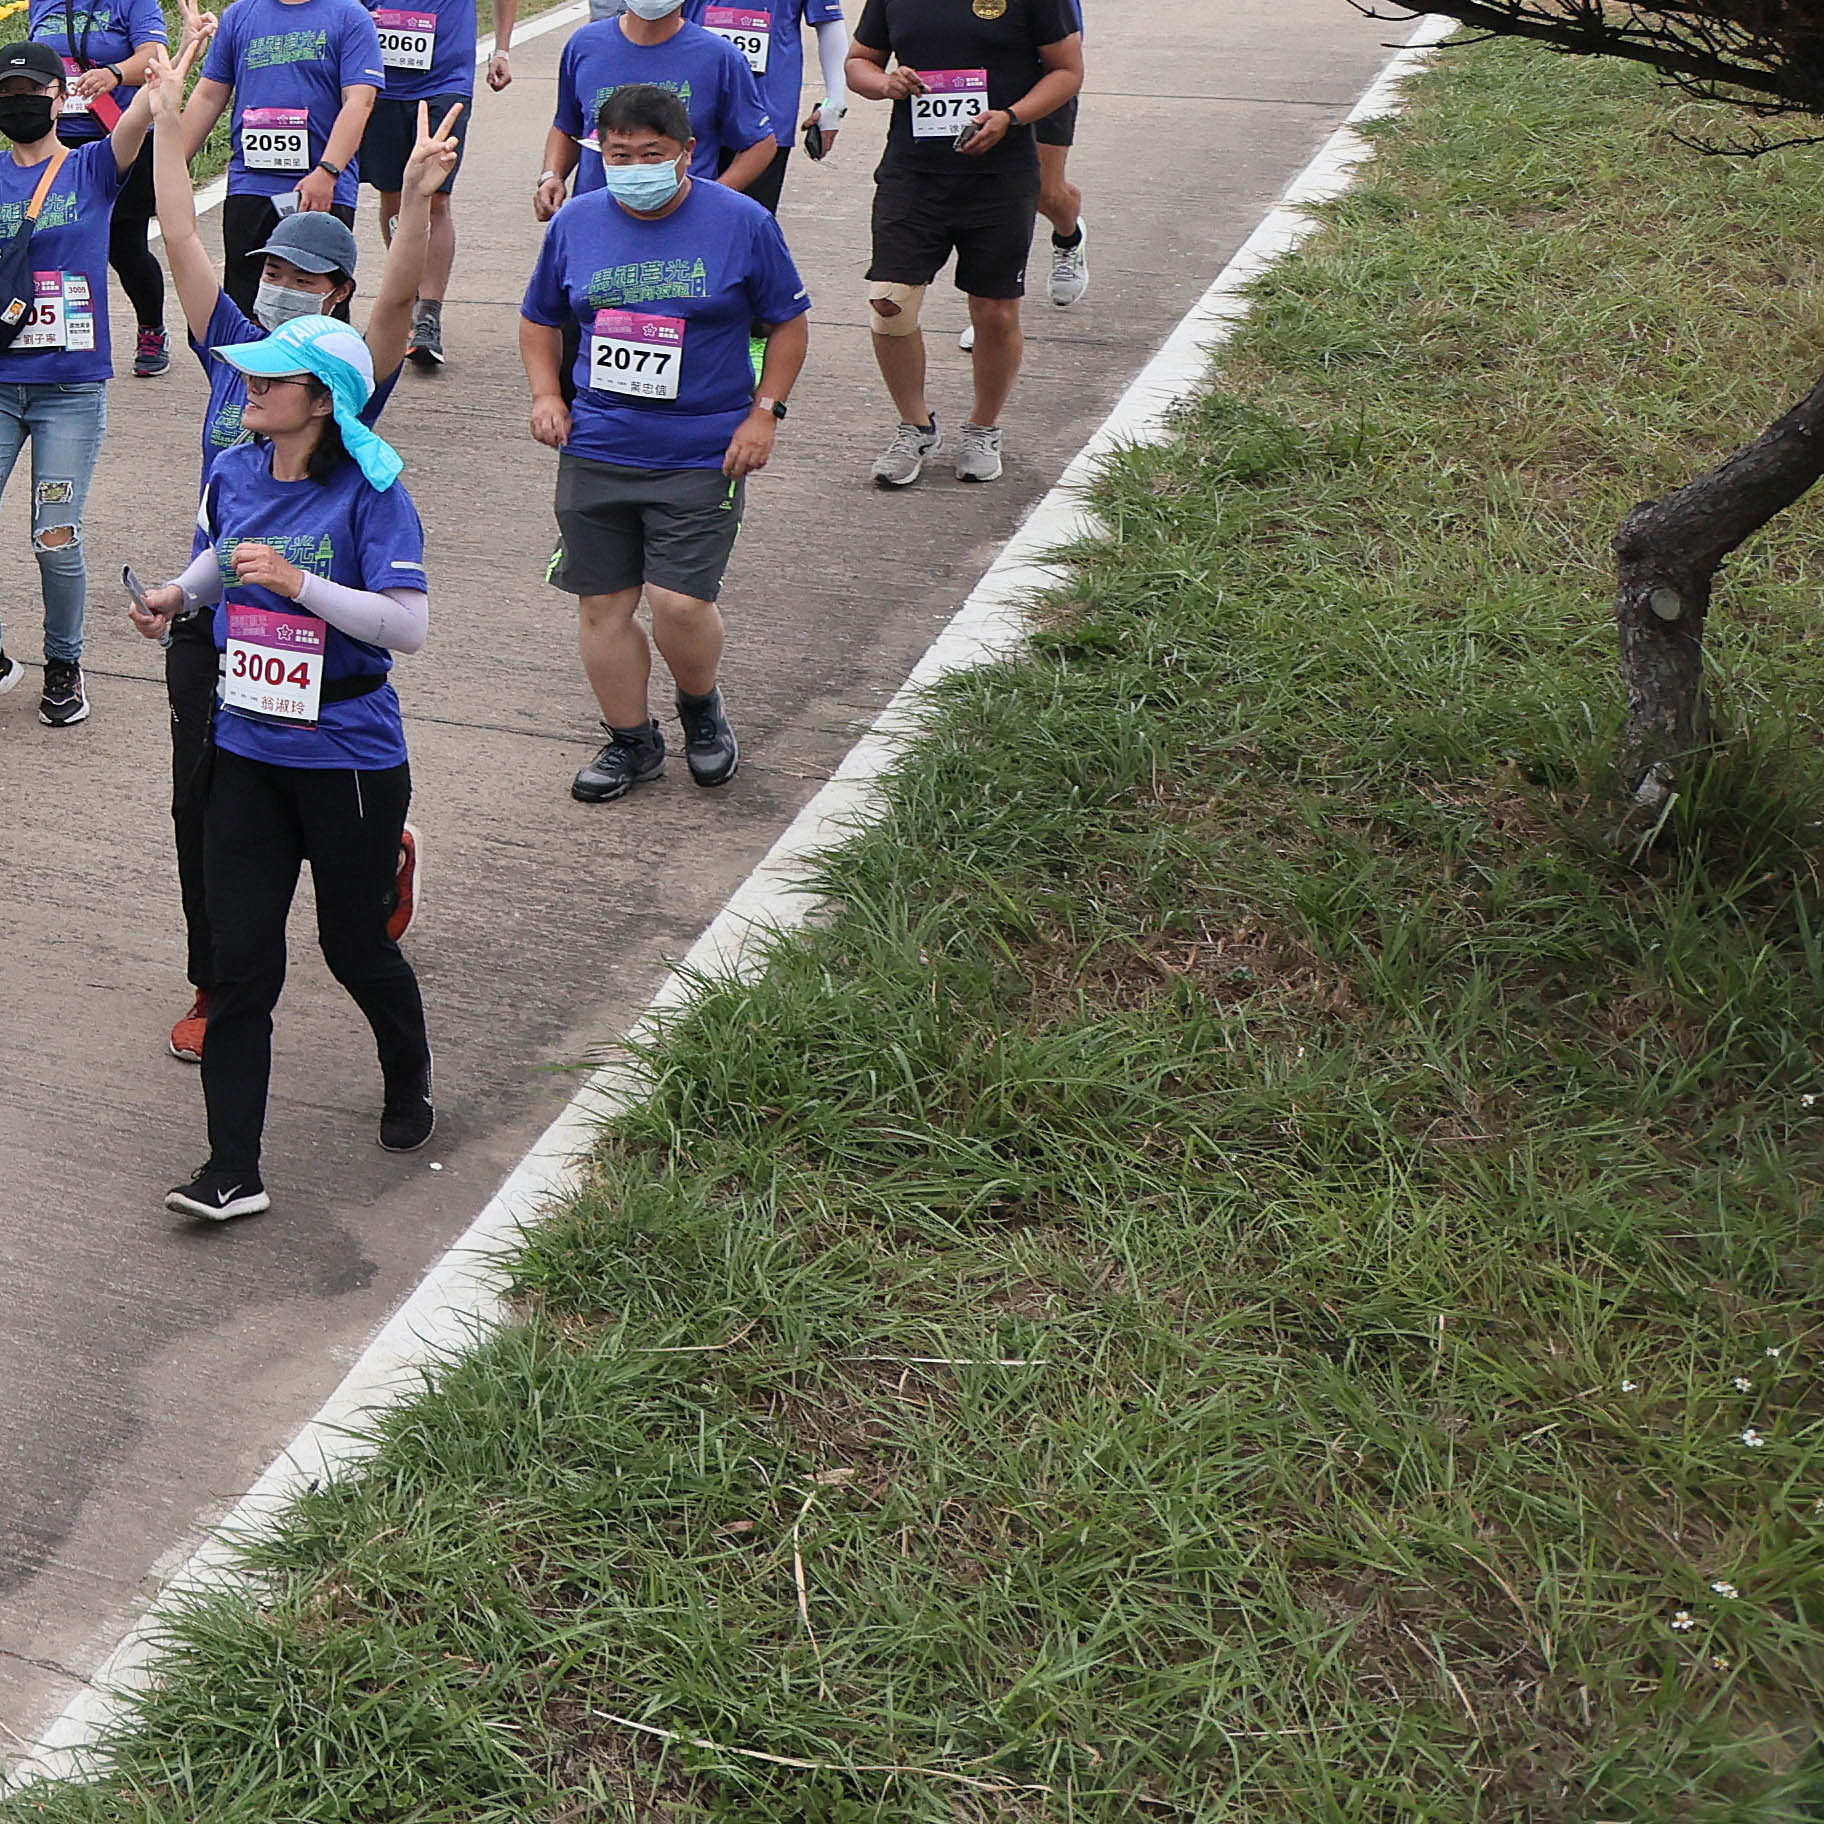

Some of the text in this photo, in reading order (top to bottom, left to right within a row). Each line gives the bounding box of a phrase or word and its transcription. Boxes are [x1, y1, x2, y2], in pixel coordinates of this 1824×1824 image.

[378, 33, 427, 53] 2060
[720, 34, 761, 54] 69
[917, 98, 981, 118] 2073
[245, 134, 302, 152] 2059
[597, 345, 672, 375] 2077
[232, 650, 311, 690] 3004
[261, 695, 305, 715] 翁淑玲
